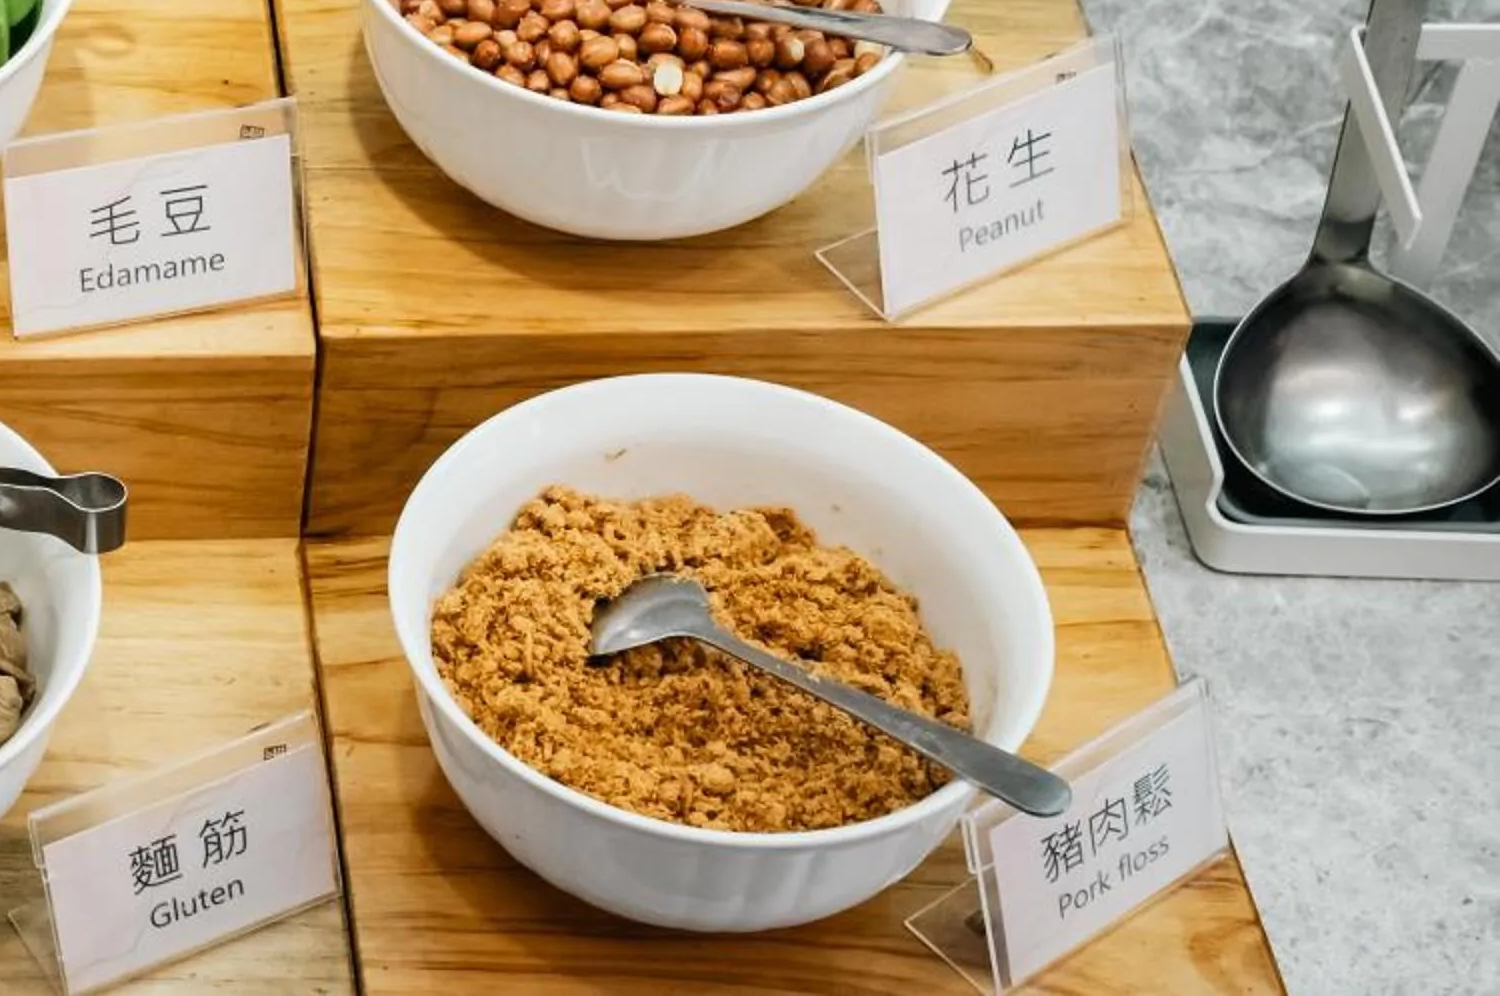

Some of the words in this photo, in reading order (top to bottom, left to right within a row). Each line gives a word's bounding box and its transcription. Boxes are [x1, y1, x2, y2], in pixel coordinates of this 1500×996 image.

[941, 128, 1055, 214] 花生
[90, 184, 212, 245] 毛豆
[958, 198, 1045, 253] Peanut
[79, 252, 226, 293] Edamame
[128, 809, 248, 896] 麵筋
[1040, 763, 1174, 884] 豬肉鬆
[150, 877, 245, 929] Gluten
[1058, 869, 1113, 920] Pork
[1118, 839, 1170, 880] floss
